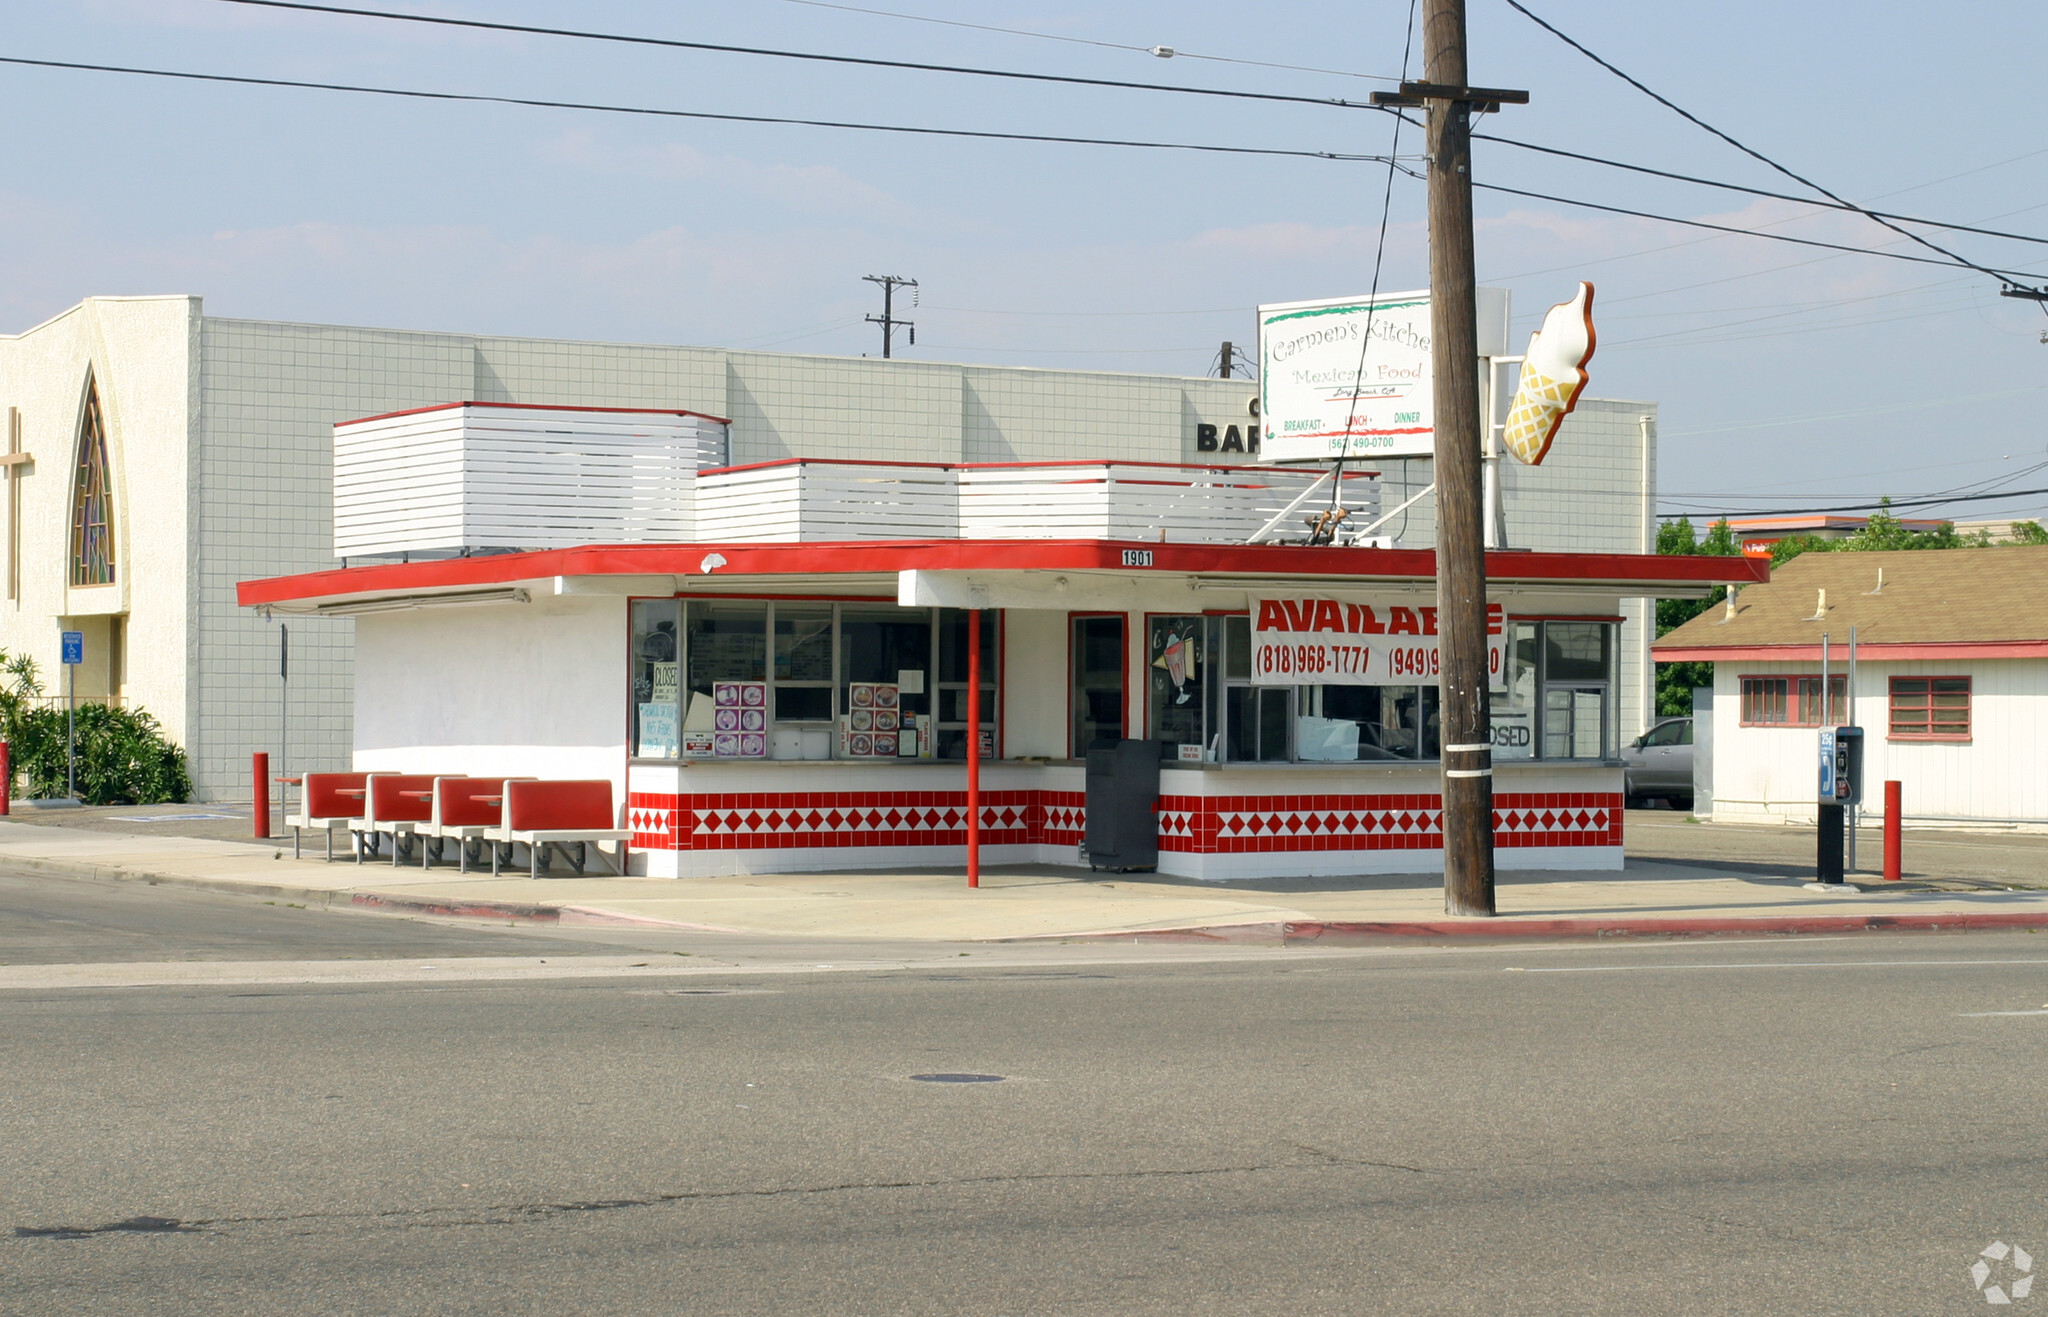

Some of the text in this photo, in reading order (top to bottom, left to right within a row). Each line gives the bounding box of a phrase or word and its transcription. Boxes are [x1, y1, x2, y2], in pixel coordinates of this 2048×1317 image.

[1273, 317, 1431, 362] Carmen's Kitche
[1292, 362, 1422, 385] Mexican Food
[1381, 387, 1396, 396] CA
[1284, 411, 1421, 432] BREAKFAST LUNCH DINNER
[1328, 437, 1394, 450] (562) 490-0700
[1124, 550, 1151, 566] 1901
[1256, 599, 1502, 635] AVAILABE
[1257, 645, 1370, 678] (818)968-7771
[1490, 725, 1531, 747] OSED
